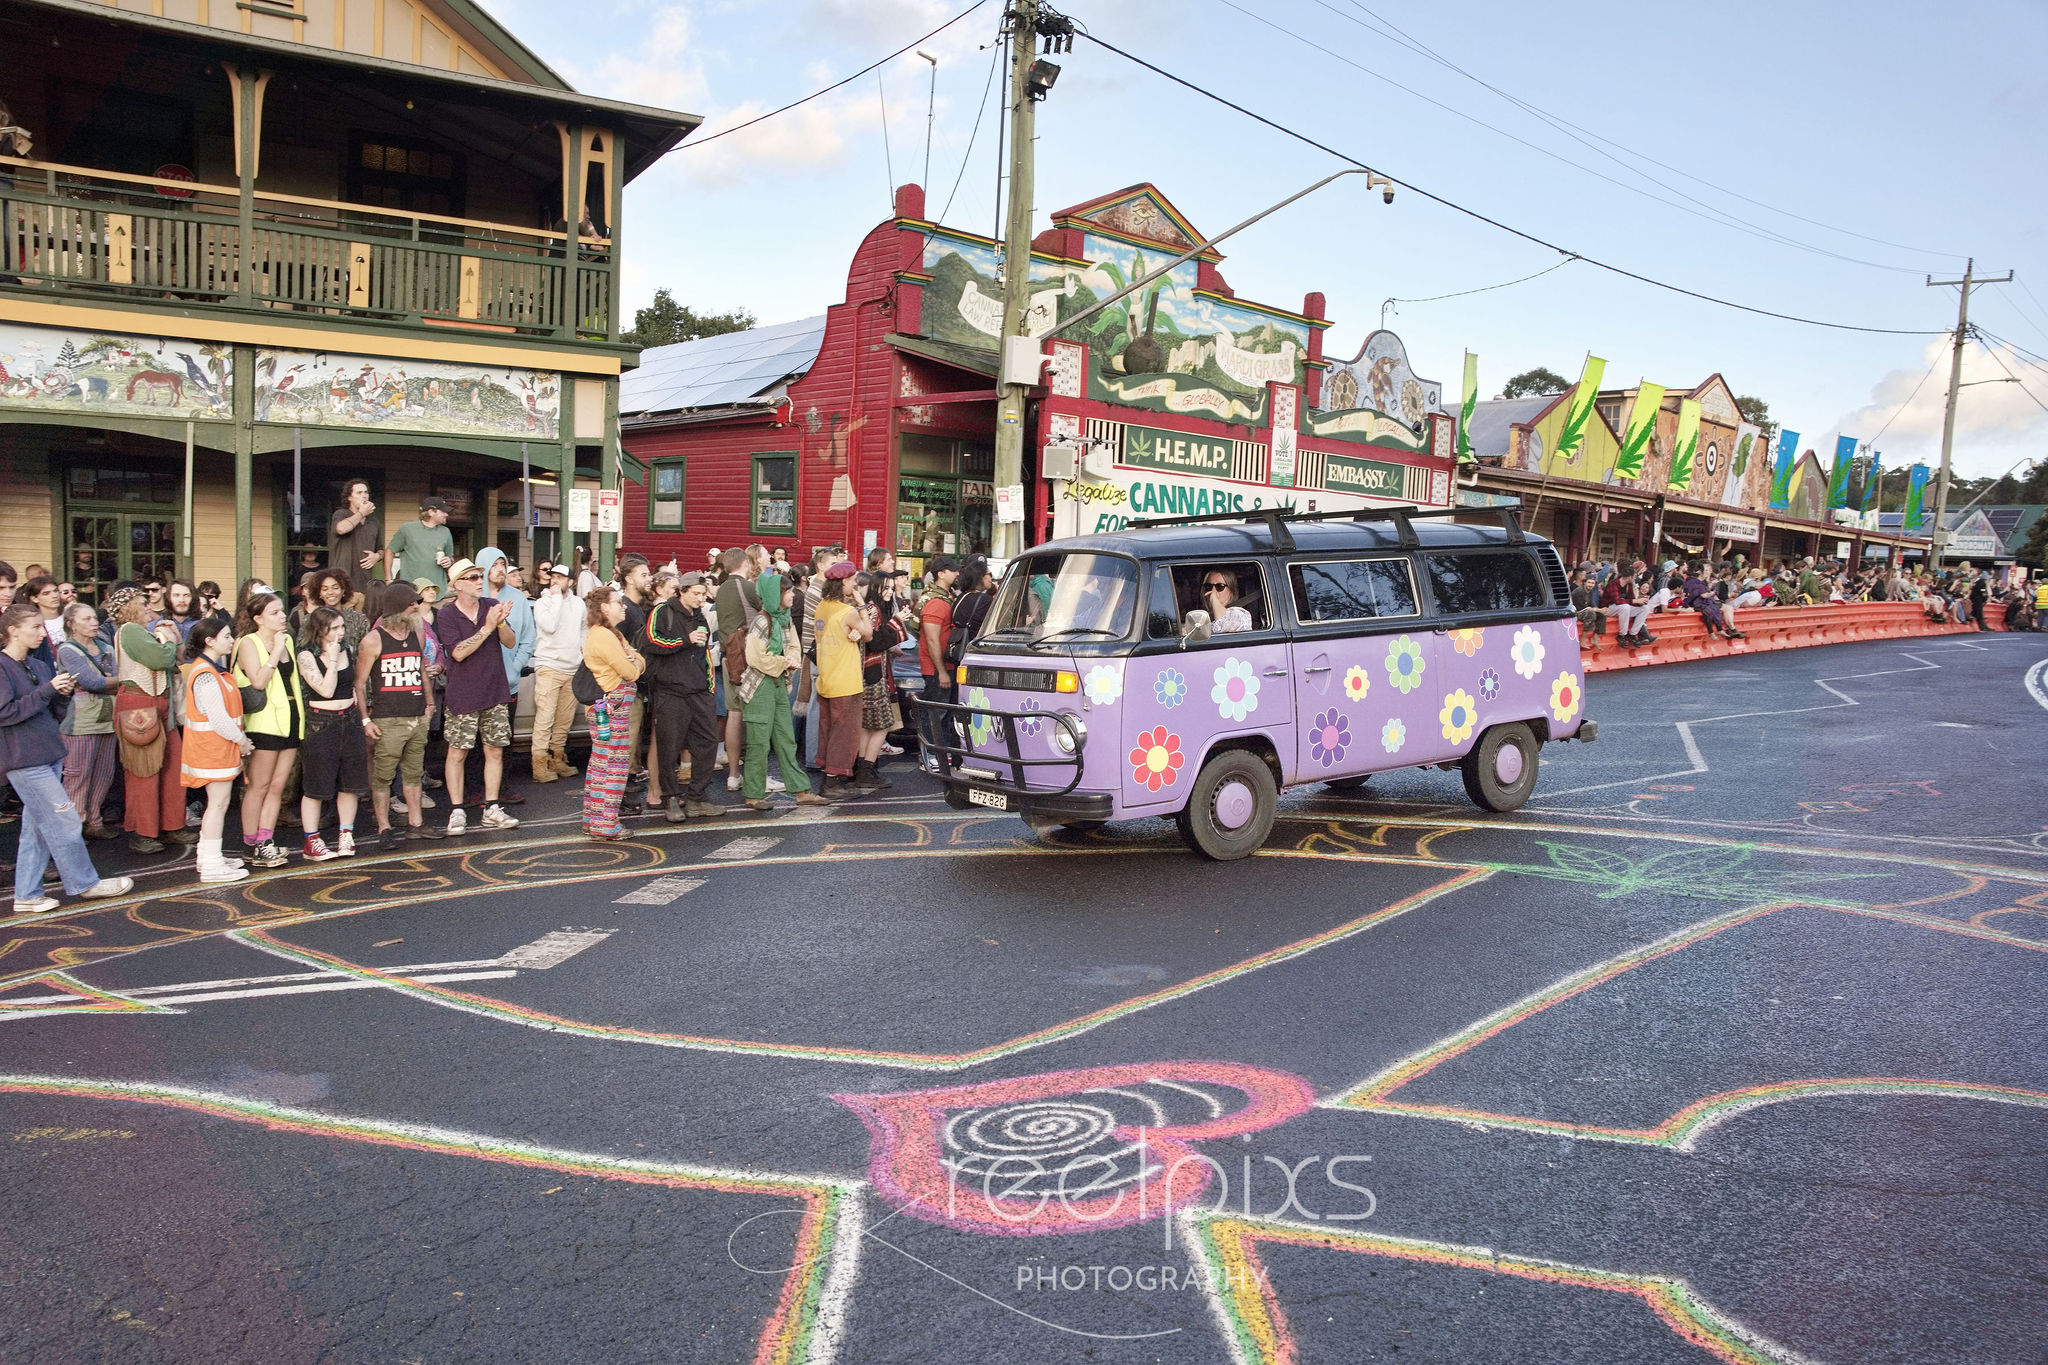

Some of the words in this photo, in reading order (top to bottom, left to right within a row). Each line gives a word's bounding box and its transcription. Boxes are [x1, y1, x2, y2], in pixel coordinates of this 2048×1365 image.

[1254, 357, 1291, 379] GRASS
[1154, 437, 1228, 469] H.E.M.P.
[1327, 463, 1387, 489] EMBASSY
[571, 492, 588, 502] 2P
[1010, 487, 1022, 497] 2P
[1062, 474, 1127, 506] Legalize
[1129, 482, 1244, 521] CANNABIS
[381, 656, 421, 673] RUN
[381, 671, 422, 687] THC
